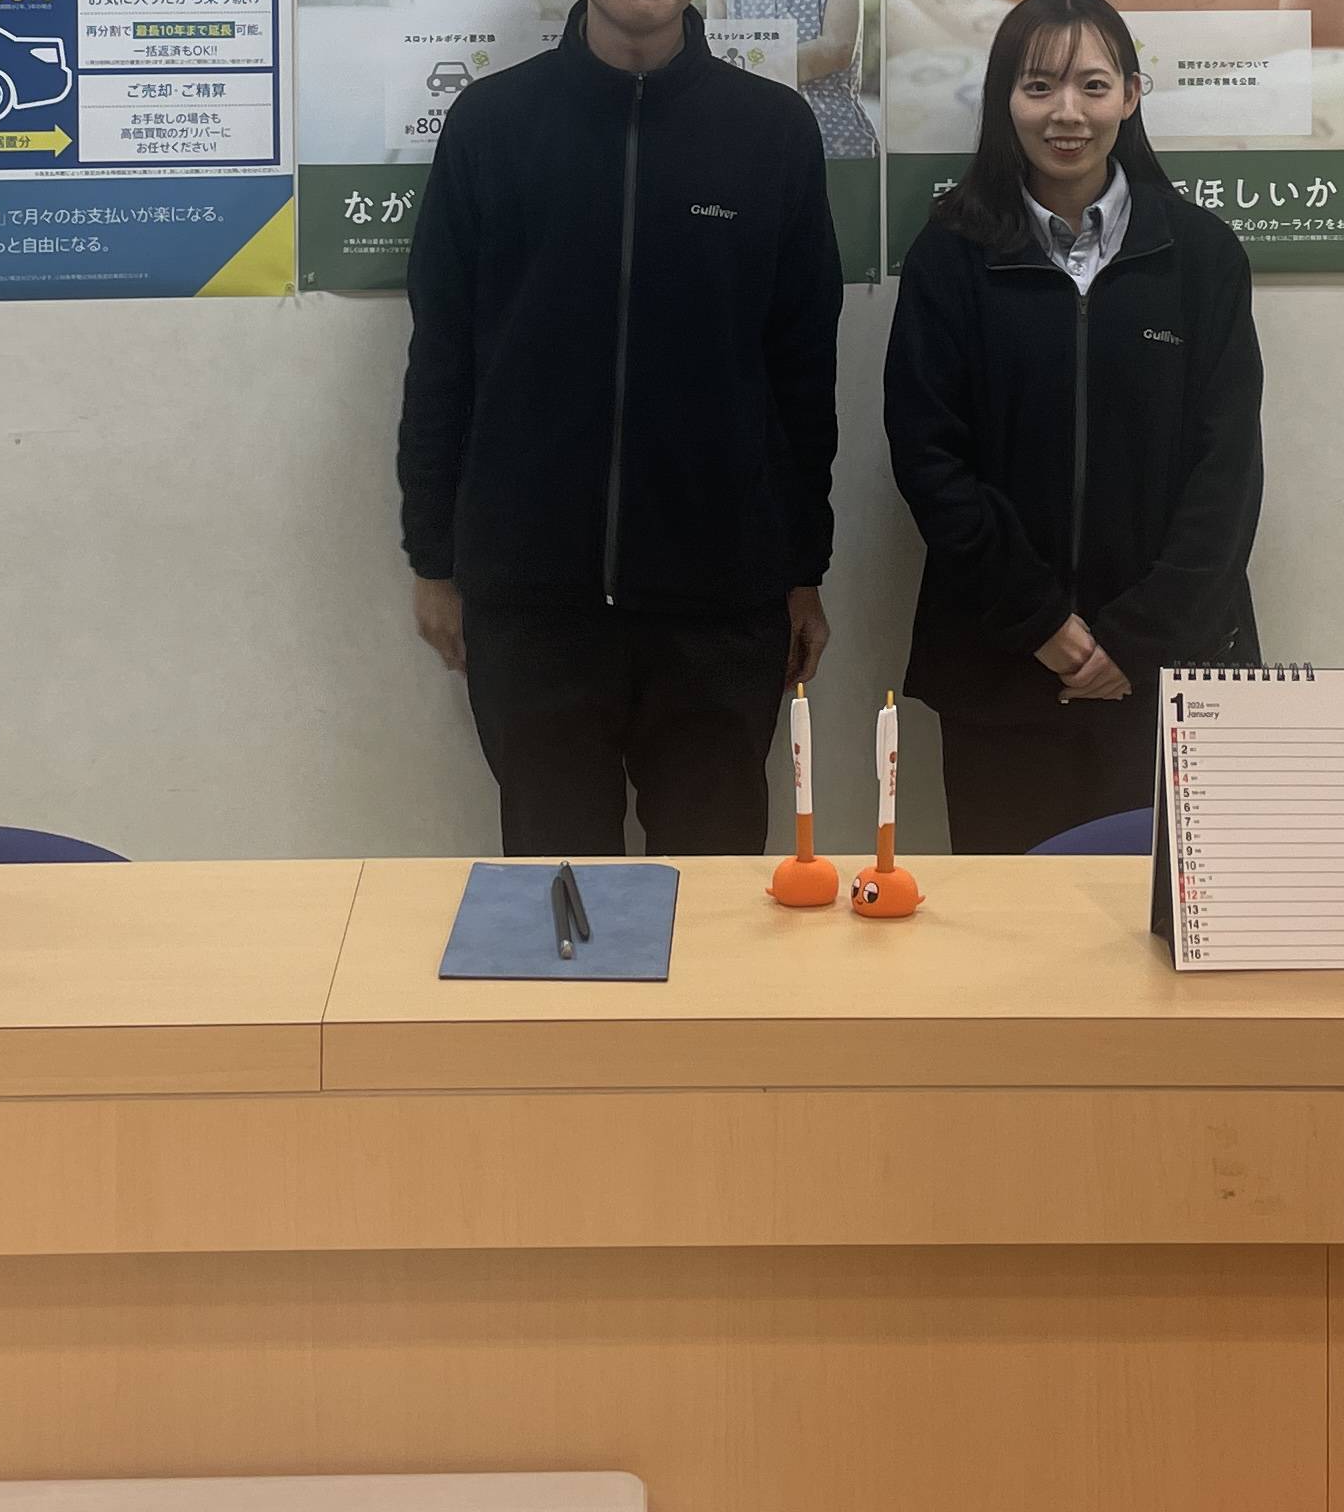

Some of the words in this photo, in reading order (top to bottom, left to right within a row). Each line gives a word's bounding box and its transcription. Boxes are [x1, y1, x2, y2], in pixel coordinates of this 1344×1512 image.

[133, 44, 218, 58] 一括返済もOK!!
[127, 82, 227, 98] ご売却・ご精算
[130, 112, 222, 125] お手放しの場合も
[120, 126, 232, 140] 高価買取のガリバーに
[136, 141, 217, 154] お任せください!
[344, 189, 416, 224] なが
[1170, 693, 1184, 722] 1
[1187, 710, 1220, 720] January
